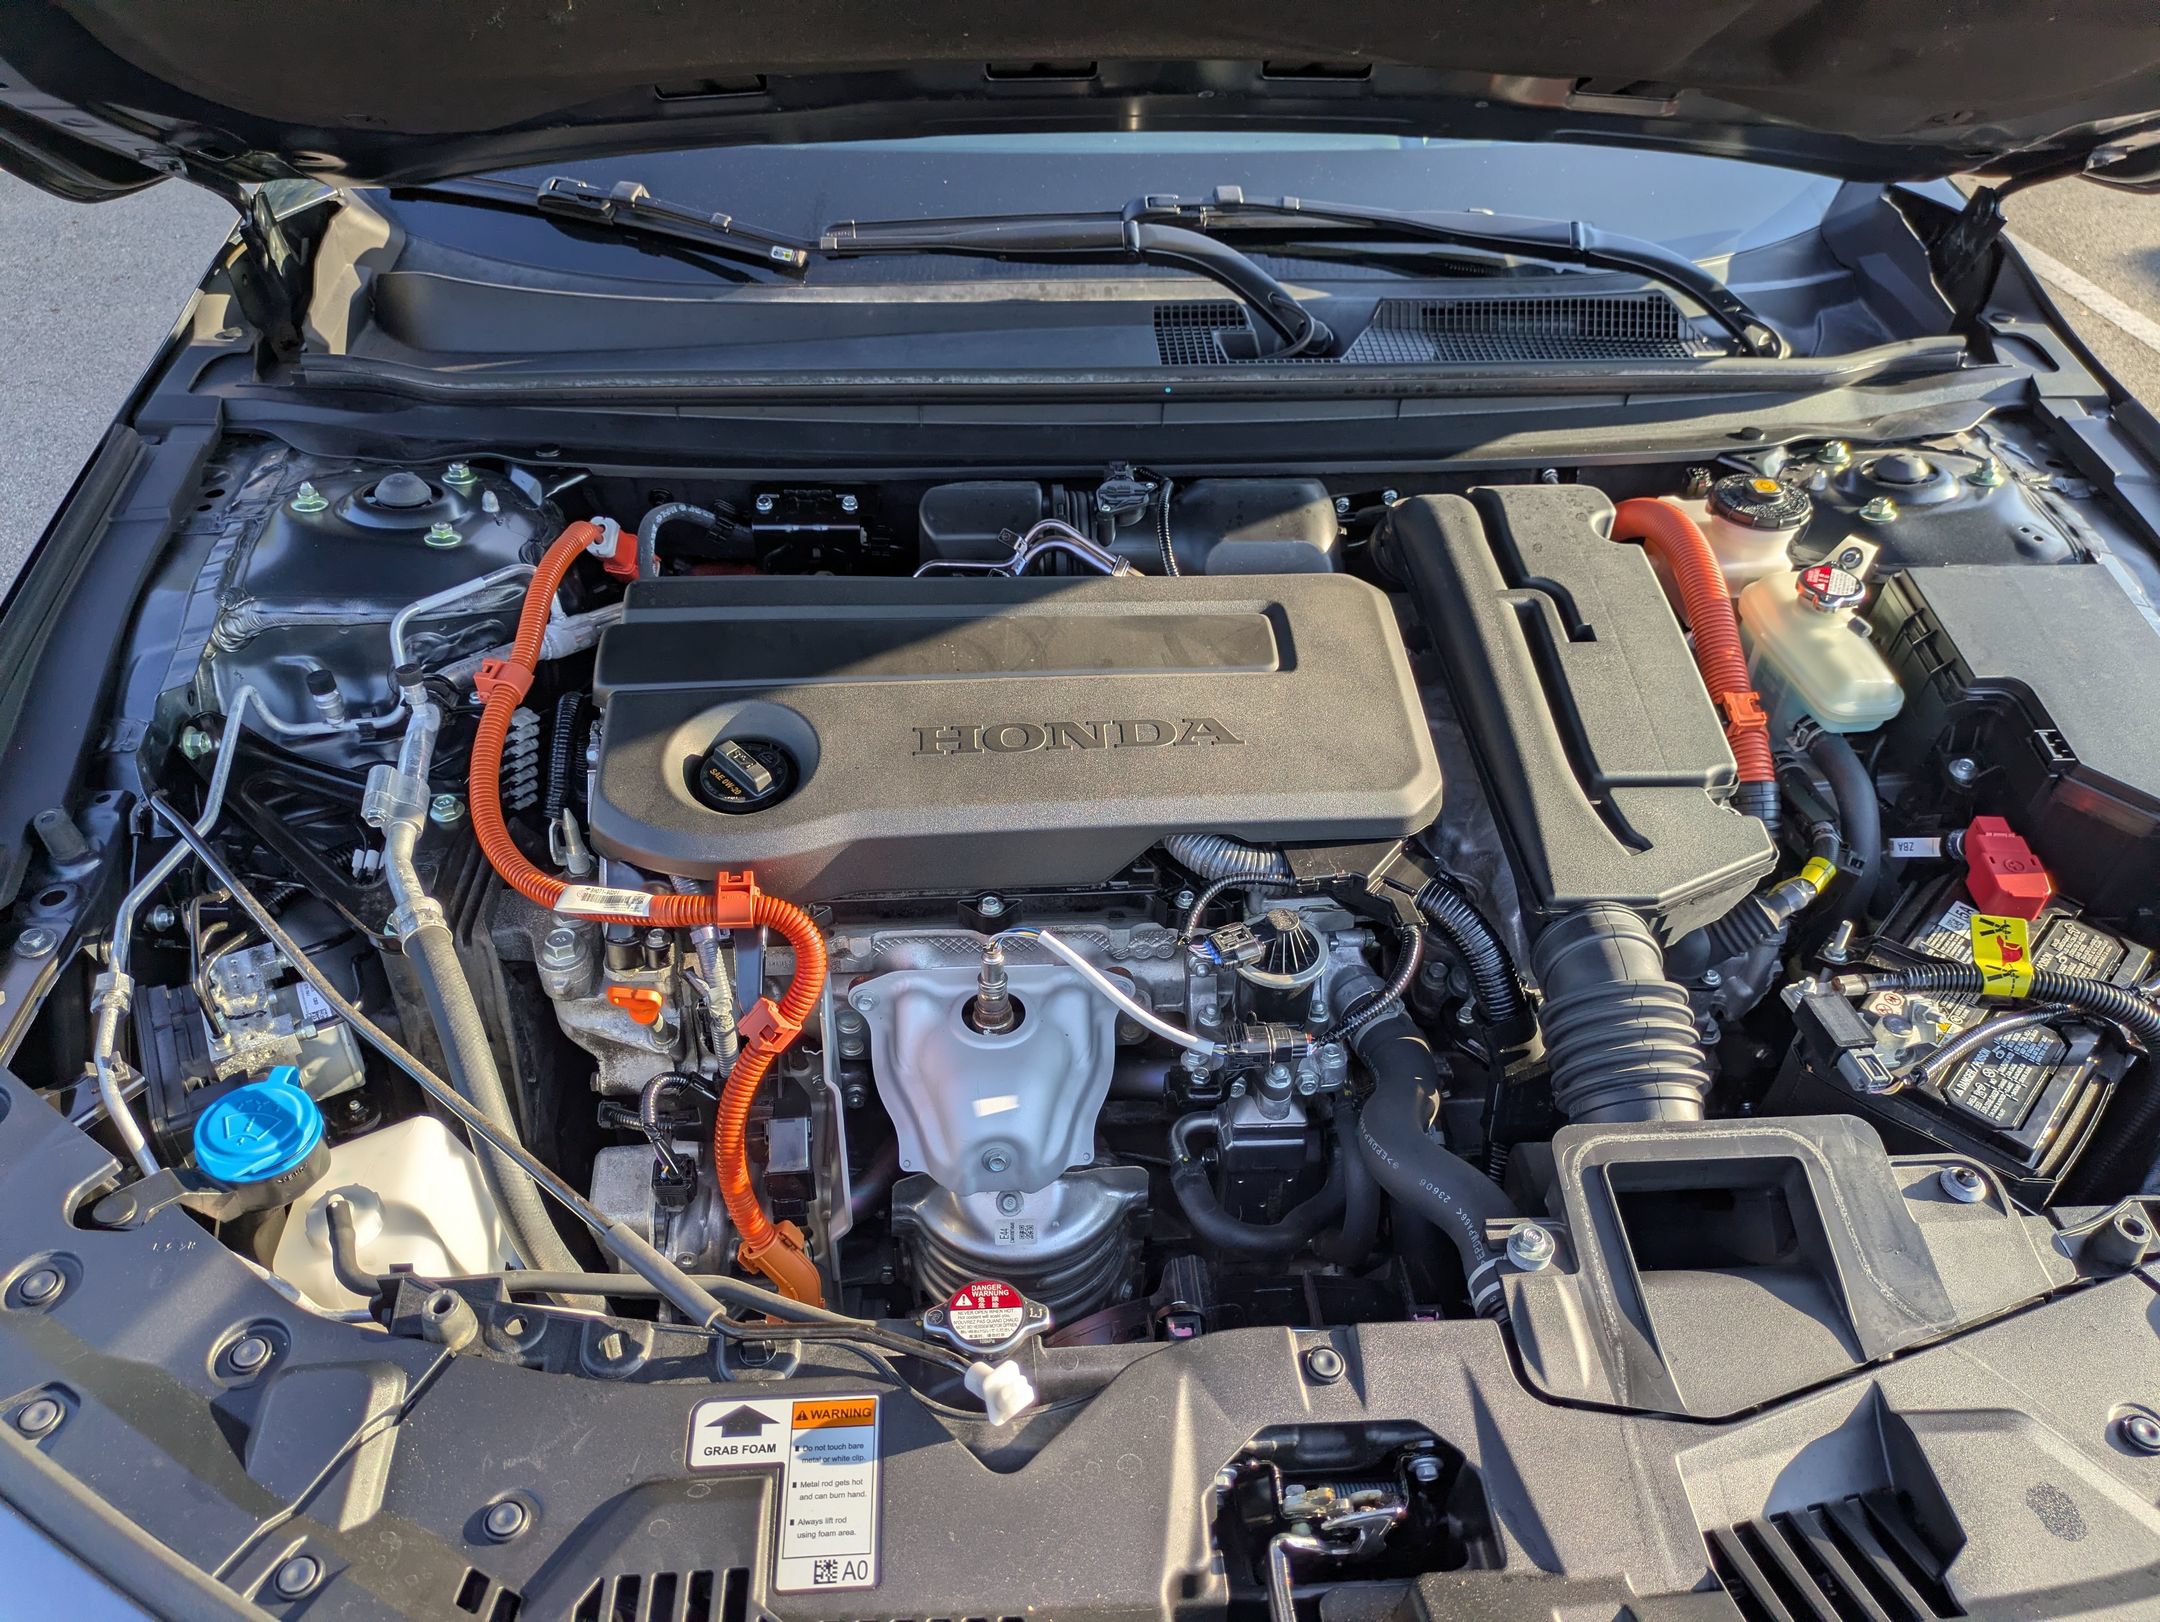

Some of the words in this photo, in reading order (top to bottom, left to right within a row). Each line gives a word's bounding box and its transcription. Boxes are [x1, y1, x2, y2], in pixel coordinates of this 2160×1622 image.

[912, 718, 1246, 755] HONDA
[709, 768, 726, 782] SAE
[722, 779, 742, 795] 0W-20
[1000, 1228, 1009, 1239] E44
[810, 1408, 872, 1419] WARNING
[703, 1446, 738, 1456] GRAB
[742, 1444, 776, 1454] FOAM
[835, 1479, 850, 1488] gets
[852, 1478, 863, 1486] hot
[798, 1518, 823, 1526] Always
[797, 1531, 816, 1539] using
[818, 1530, 836, 1538] foam
[842, 1560, 868, 1581] A0
